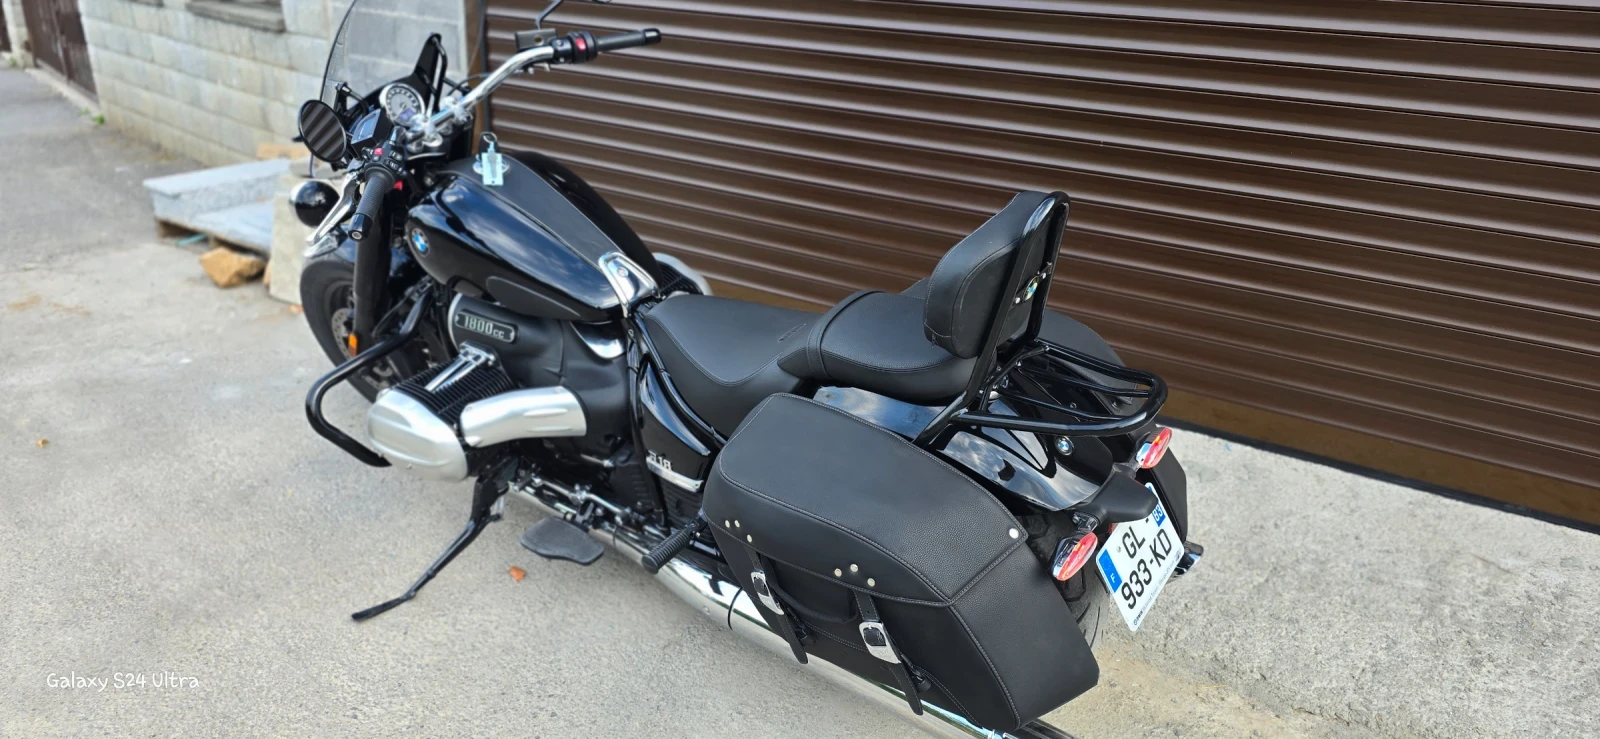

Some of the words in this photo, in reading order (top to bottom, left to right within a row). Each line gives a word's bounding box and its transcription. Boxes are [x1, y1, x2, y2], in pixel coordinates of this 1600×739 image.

[464, 315, 505, 339] 1800cc
[1152, 504, 1163, 522] 83
[1110, 572, 1115, 584] F
[1121, 528, 1172, 610] 933-KD
